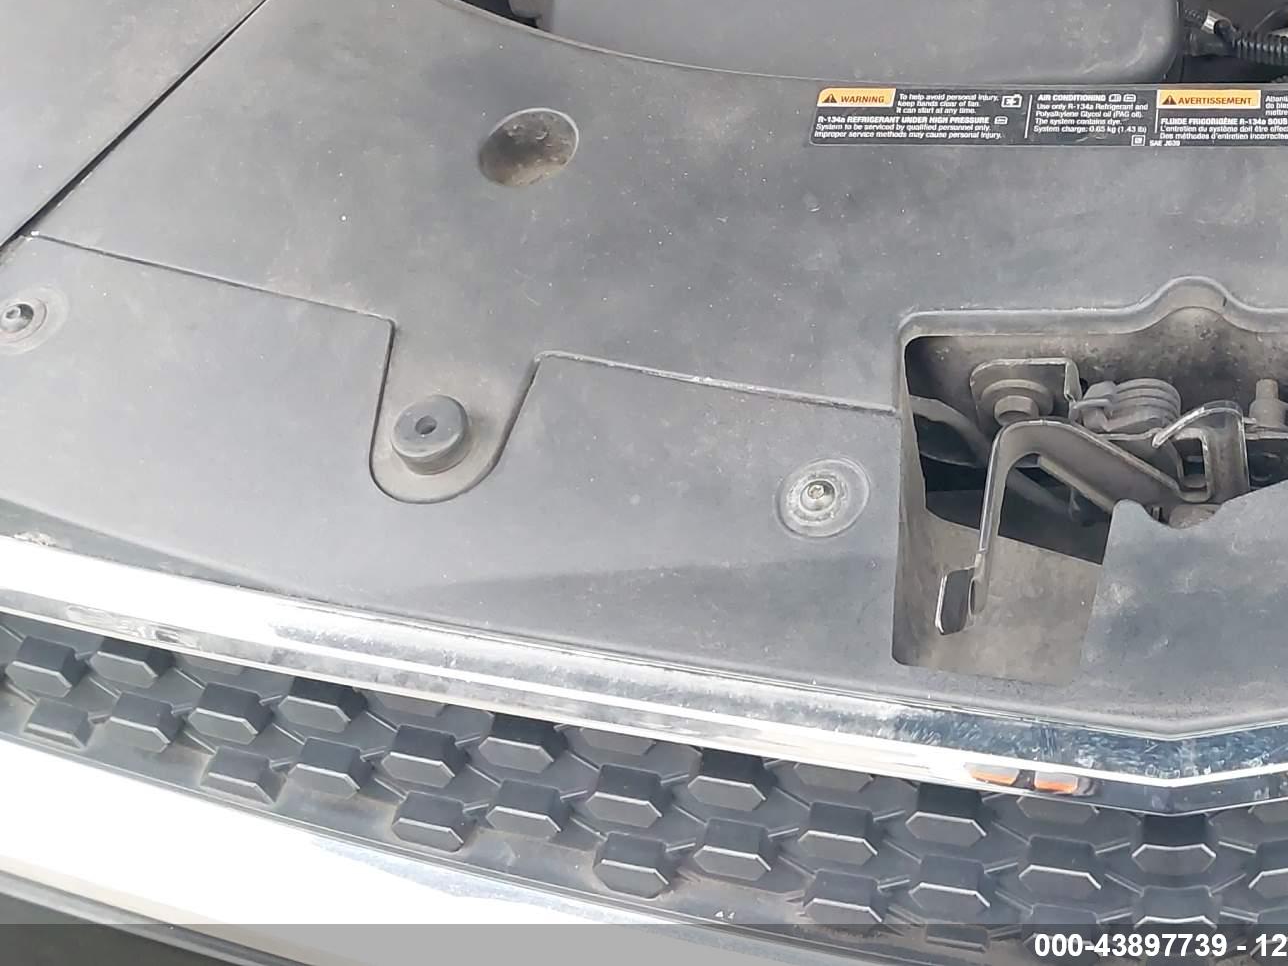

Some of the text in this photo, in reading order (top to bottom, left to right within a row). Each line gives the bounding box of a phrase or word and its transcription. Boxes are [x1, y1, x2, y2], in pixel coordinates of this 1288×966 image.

[841, 95, 885, 103] WARNING
[909, 94, 925, 102] help
[946, 94, 977, 102] personal
[1178, 97, 1252, 105] AVERTISSEMENT
[944, 107, 958, 115] any
[818, 115, 990, 124] R-134a REFRIGERANT UNDER HIGH PRESSURE
[1107, 118, 1122, 126] dye.
[1160, 117, 1188, 125] FLUIDE
[1188, 116, 1238, 125] FRIGORIGÈNE
[1239, 117, 1267, 125] R-134a
[1267, 117, 1288, 125] SOUS
[906, 124, 937, 132] qualified
[938, 124, 974, 132] personnel
[974, 124, 991, 132] only.
[1209, 125, 1238, 133] système
[980, 132, 1002, 140] injury.
